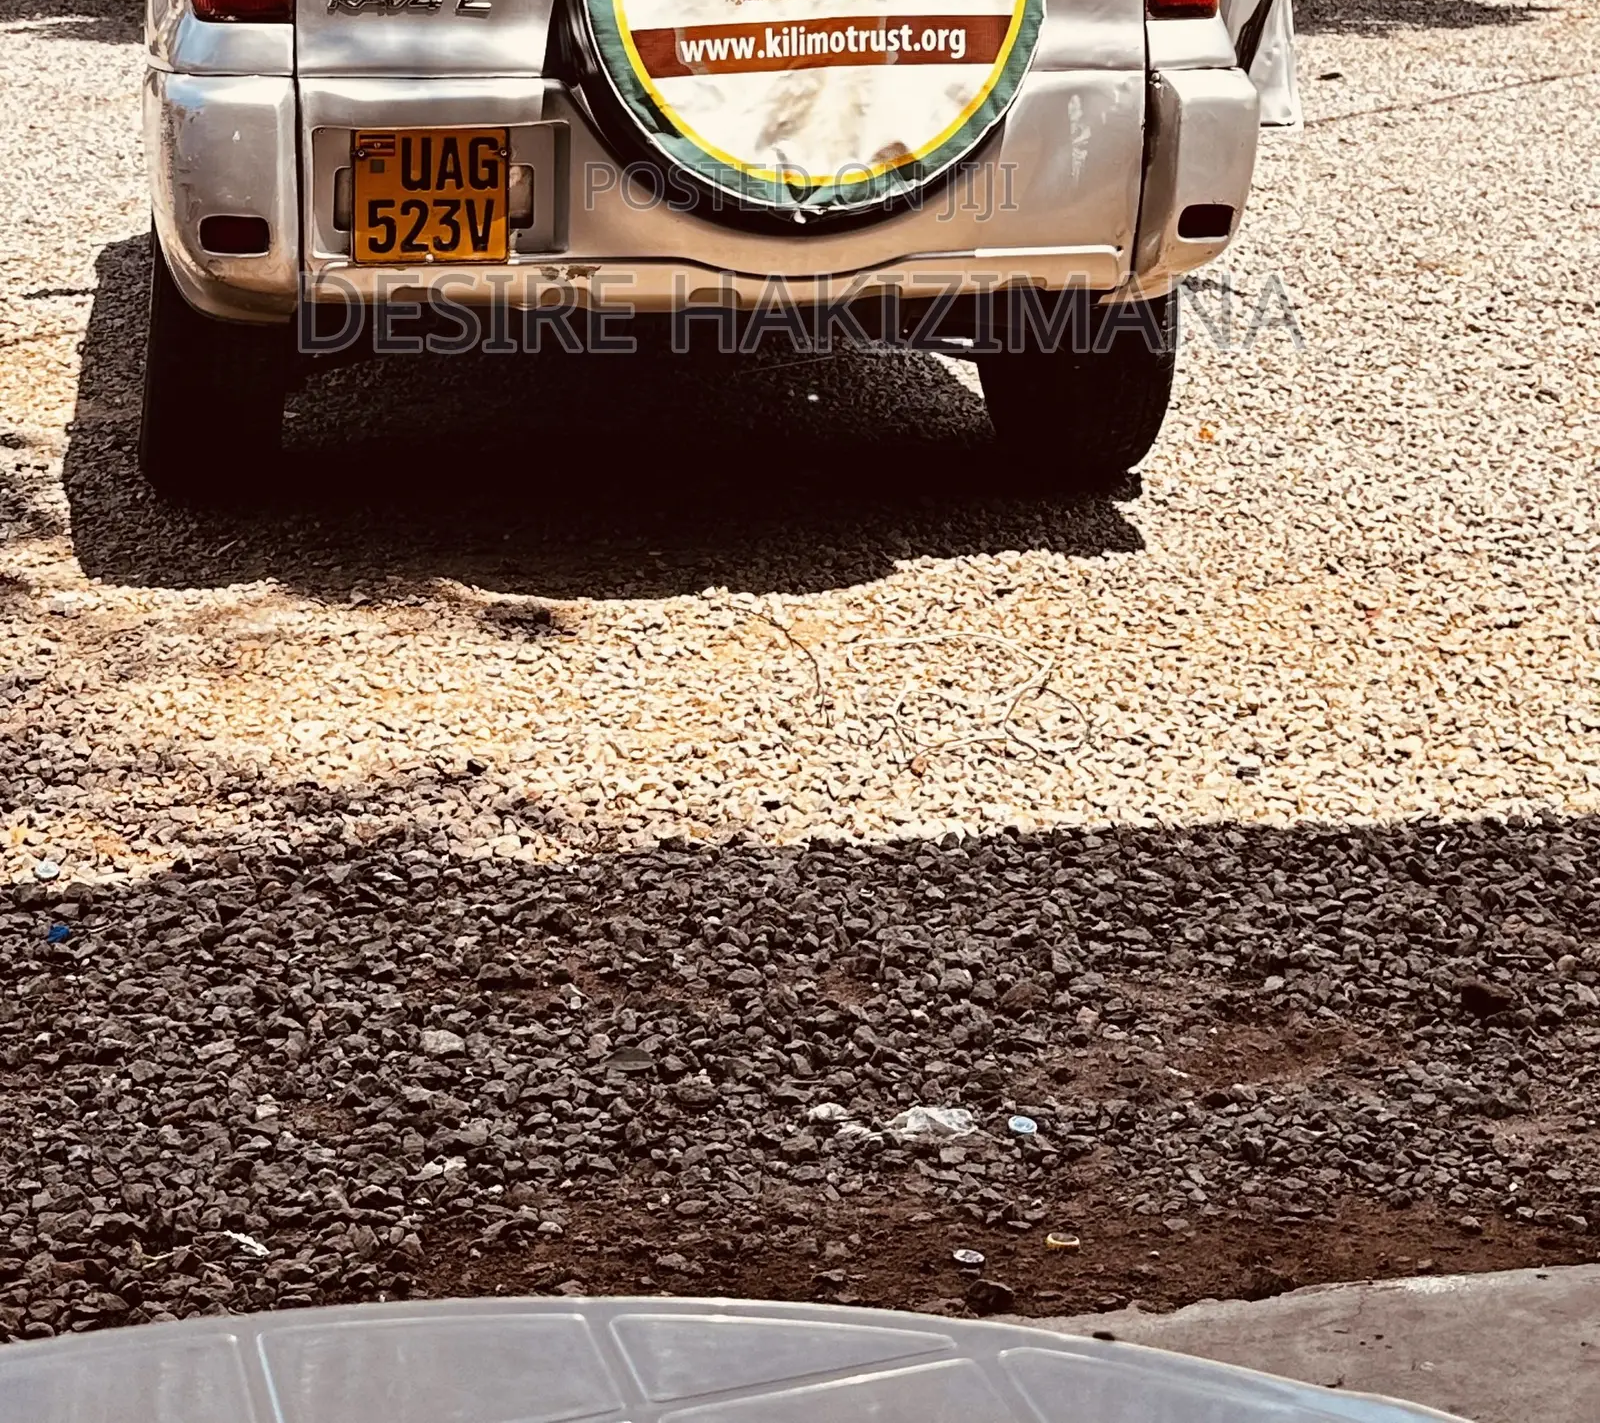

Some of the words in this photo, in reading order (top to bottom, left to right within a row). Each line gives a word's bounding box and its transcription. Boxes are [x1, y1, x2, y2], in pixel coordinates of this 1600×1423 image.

[679, 24, 966, 63] www.kilimotrust.org
[401, 137, 499, 191] UAG
[368, 198, 495, 253] 523V
